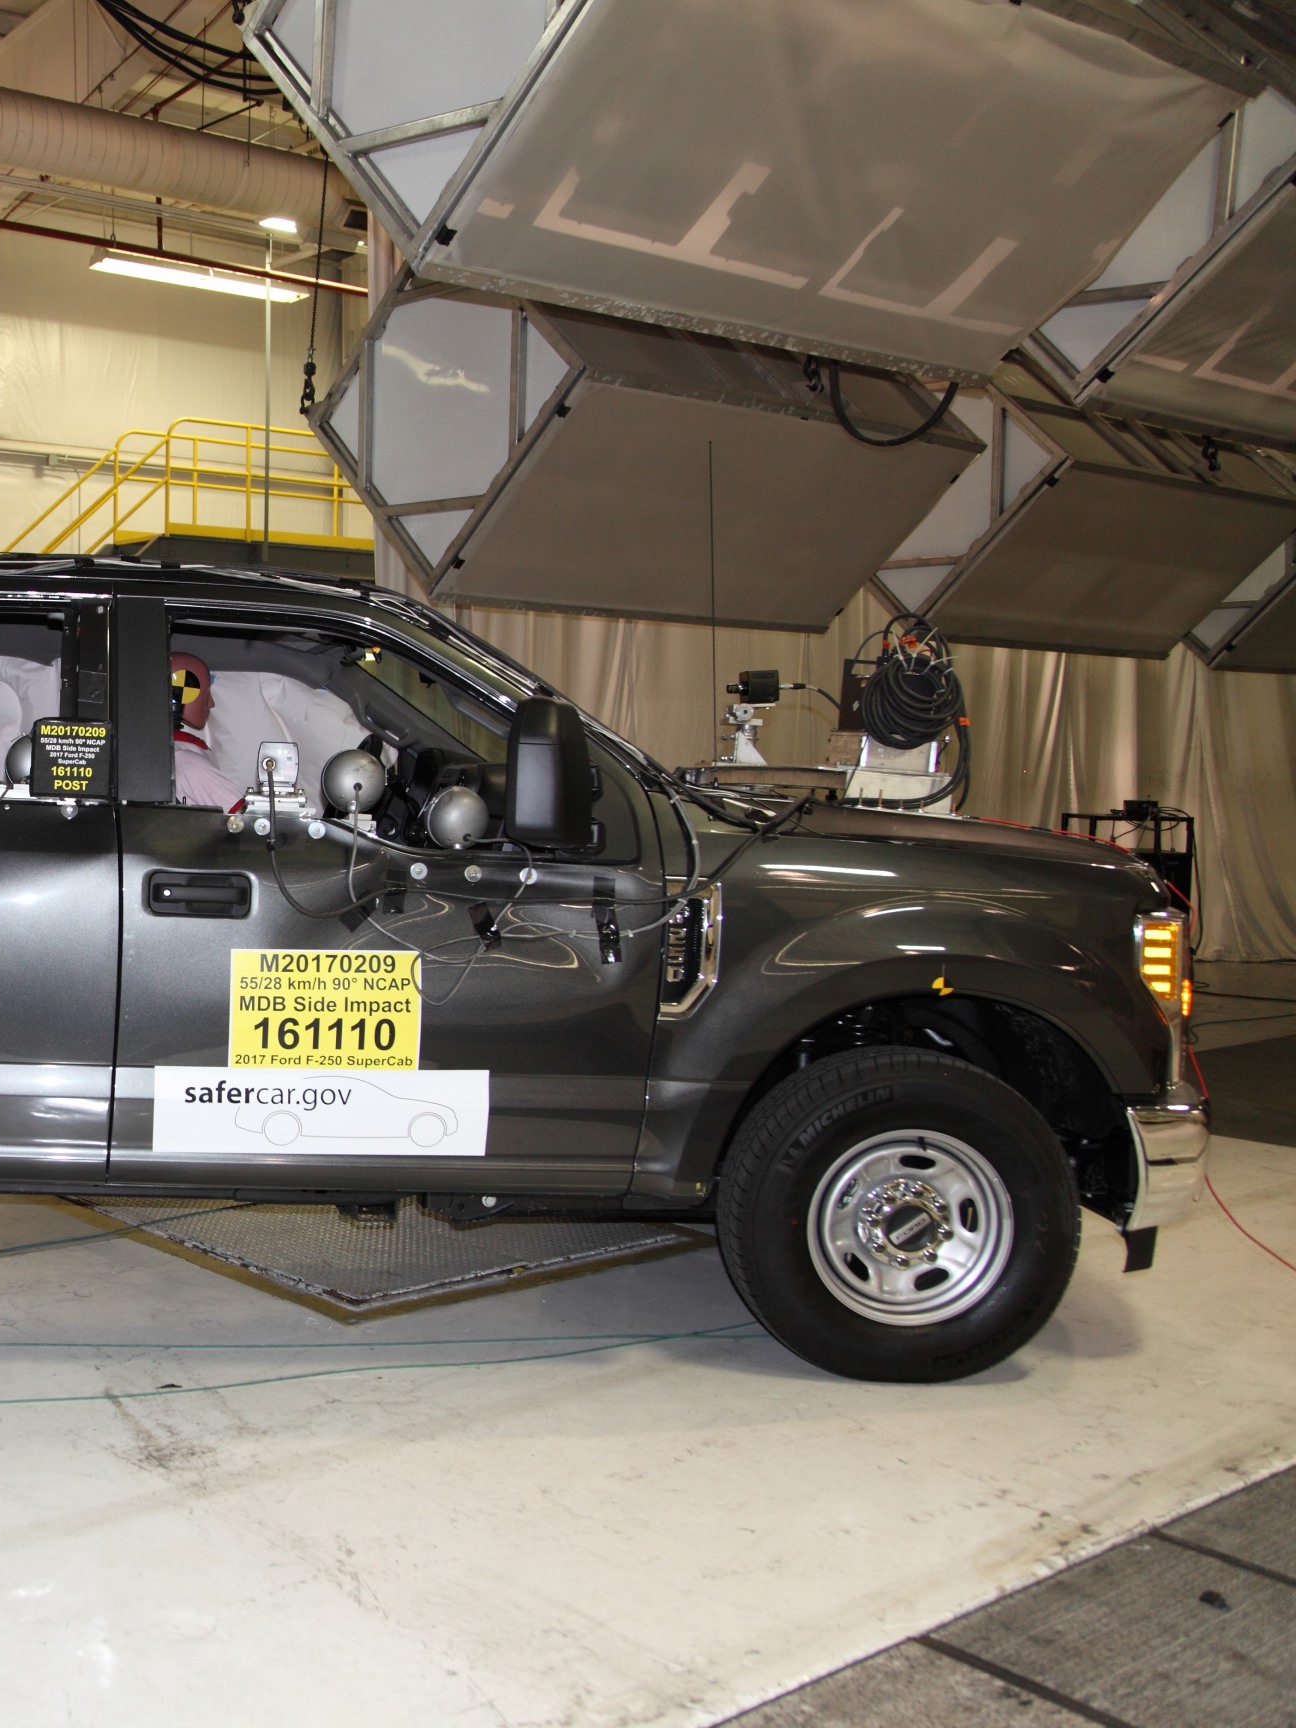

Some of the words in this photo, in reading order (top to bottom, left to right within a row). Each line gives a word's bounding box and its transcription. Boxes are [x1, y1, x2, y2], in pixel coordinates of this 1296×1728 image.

[40, 725, 106, 737] M20170209
[51, 766, 93, 777] 161110
[54, 780, 89, 791] POST
[260, 953, 396, 974] M20170209
[239, 976, 282, 990] 55/28
[288, 977, 327, 991] km/h
[332, 977, 358, 991] 90°
[363, 978, 411, 991] NCAP
[239, 995, 287, 1012] MDB
[293, 996, 337, 1013] Side
[344, 997, 412, 1016] Impact
[254, 1016, 396, 1051] 161110
[235, 1054, 266, 1065] 2017
[270, 1055, 301, 1066] Ford
[306, 1055, 343, 1066] F-250
[347, 1055, 413, 1068] SuperCab
[184, 1080, 352, 1111] safercar.gov
[798, 1085, 892, 1147] MICHELIN
